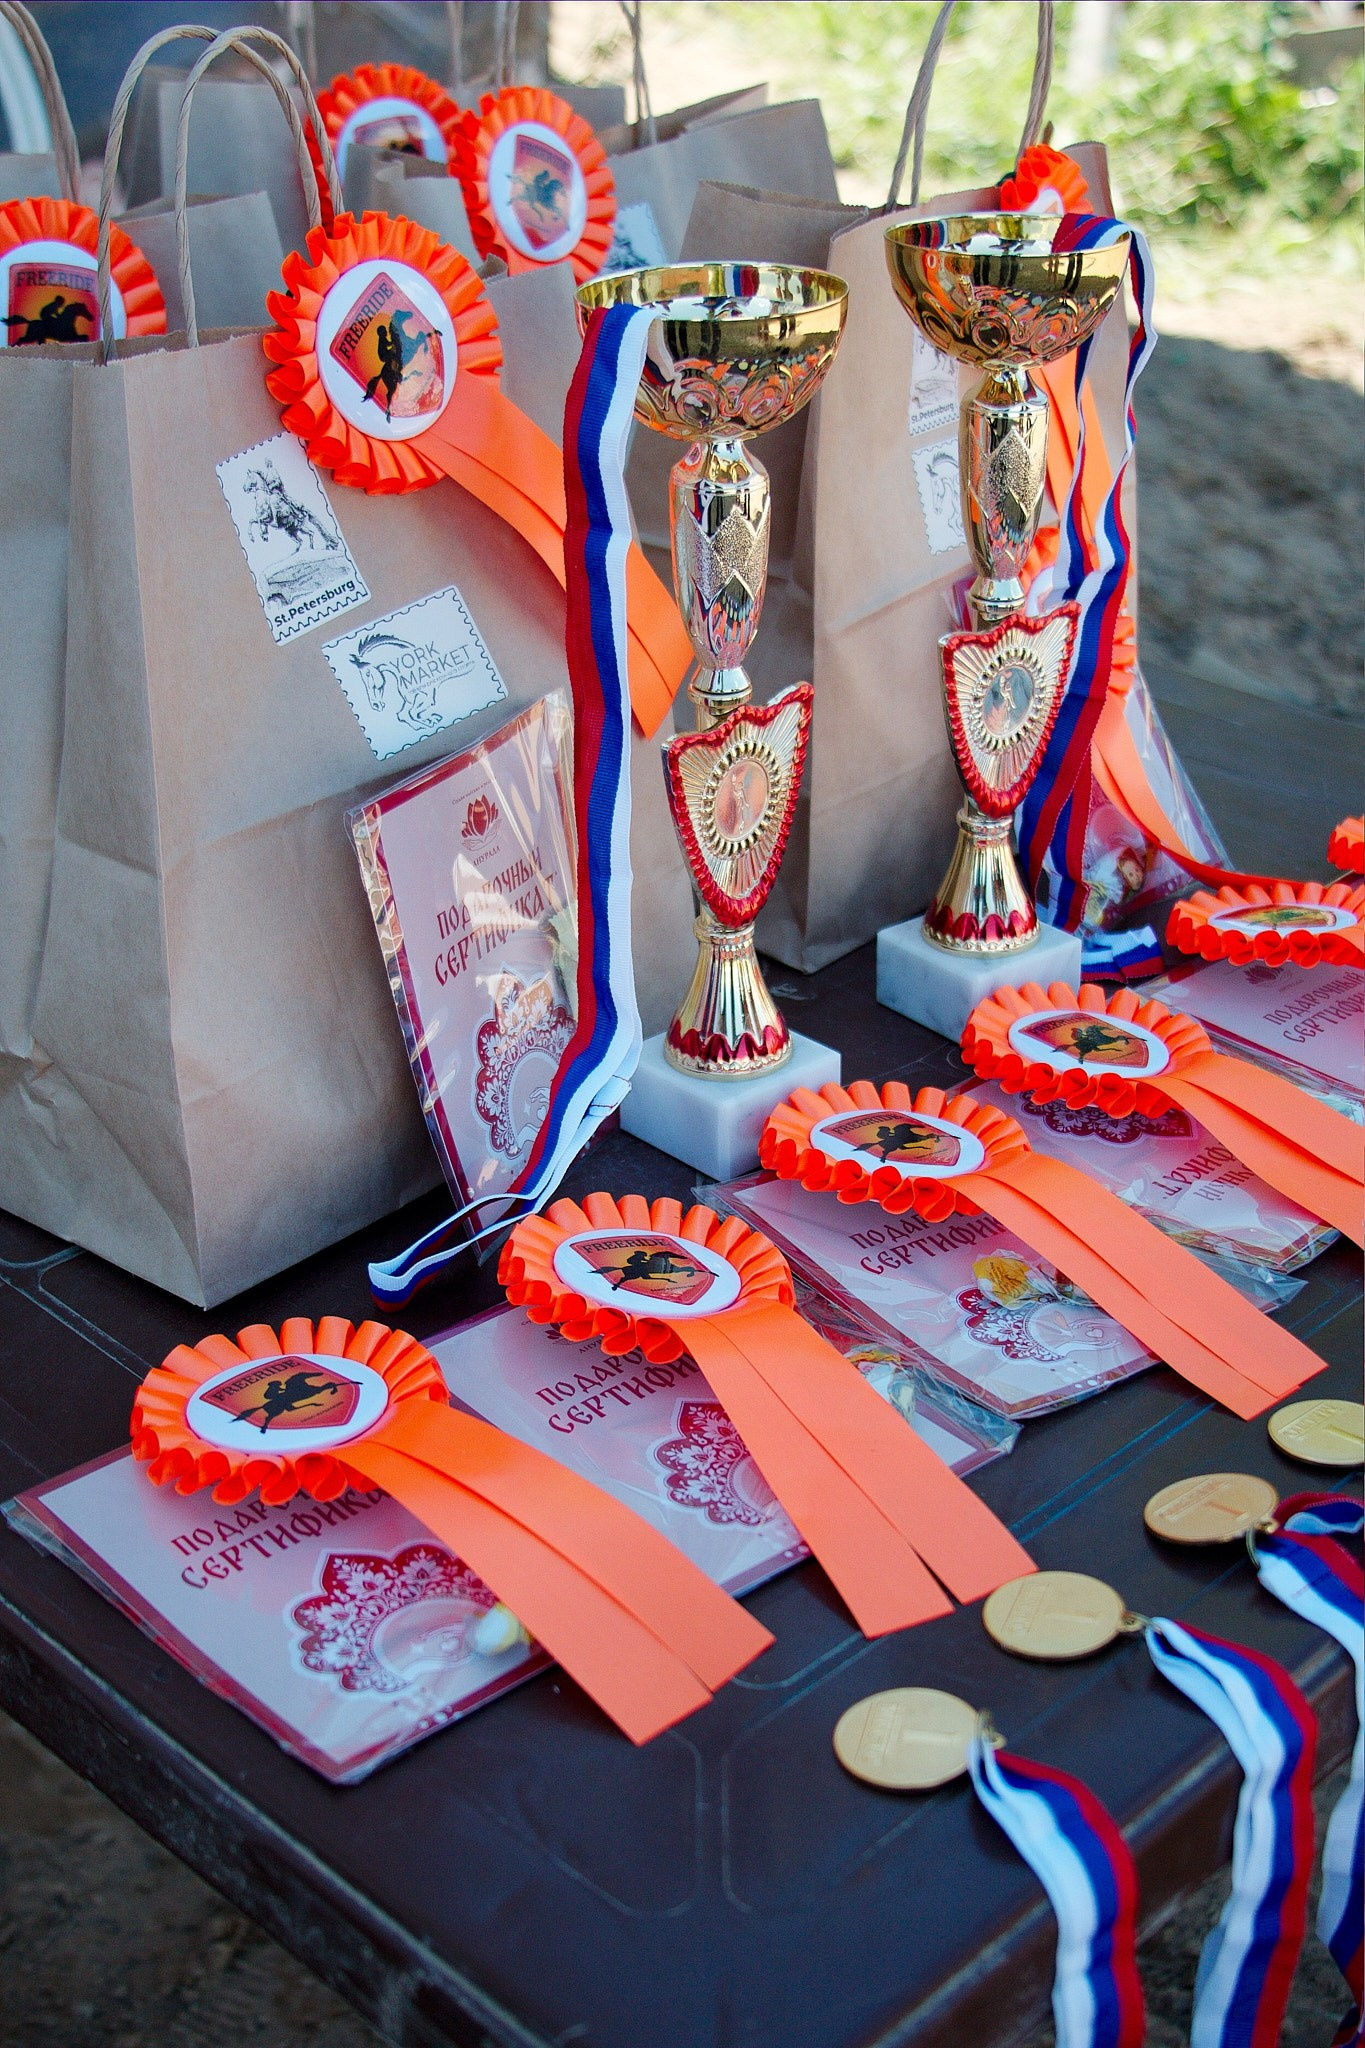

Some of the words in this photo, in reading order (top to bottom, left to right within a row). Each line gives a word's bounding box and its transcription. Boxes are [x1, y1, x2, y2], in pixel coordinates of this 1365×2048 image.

[16, 270, 95, 293] FREERIDE
[338, 282, 394, 361] FREERIDE
[274, 580, 356, 628] St.Petersburg
[389, 641, 440, 674] YORK
[399, 644, 470, 690] MARKET
[581, 1238, 672, 1254] FREERIDE
[212, 1359, 301, 1402] FREERIDE
[535, 1346, 644, 1406] ПОДАРО
